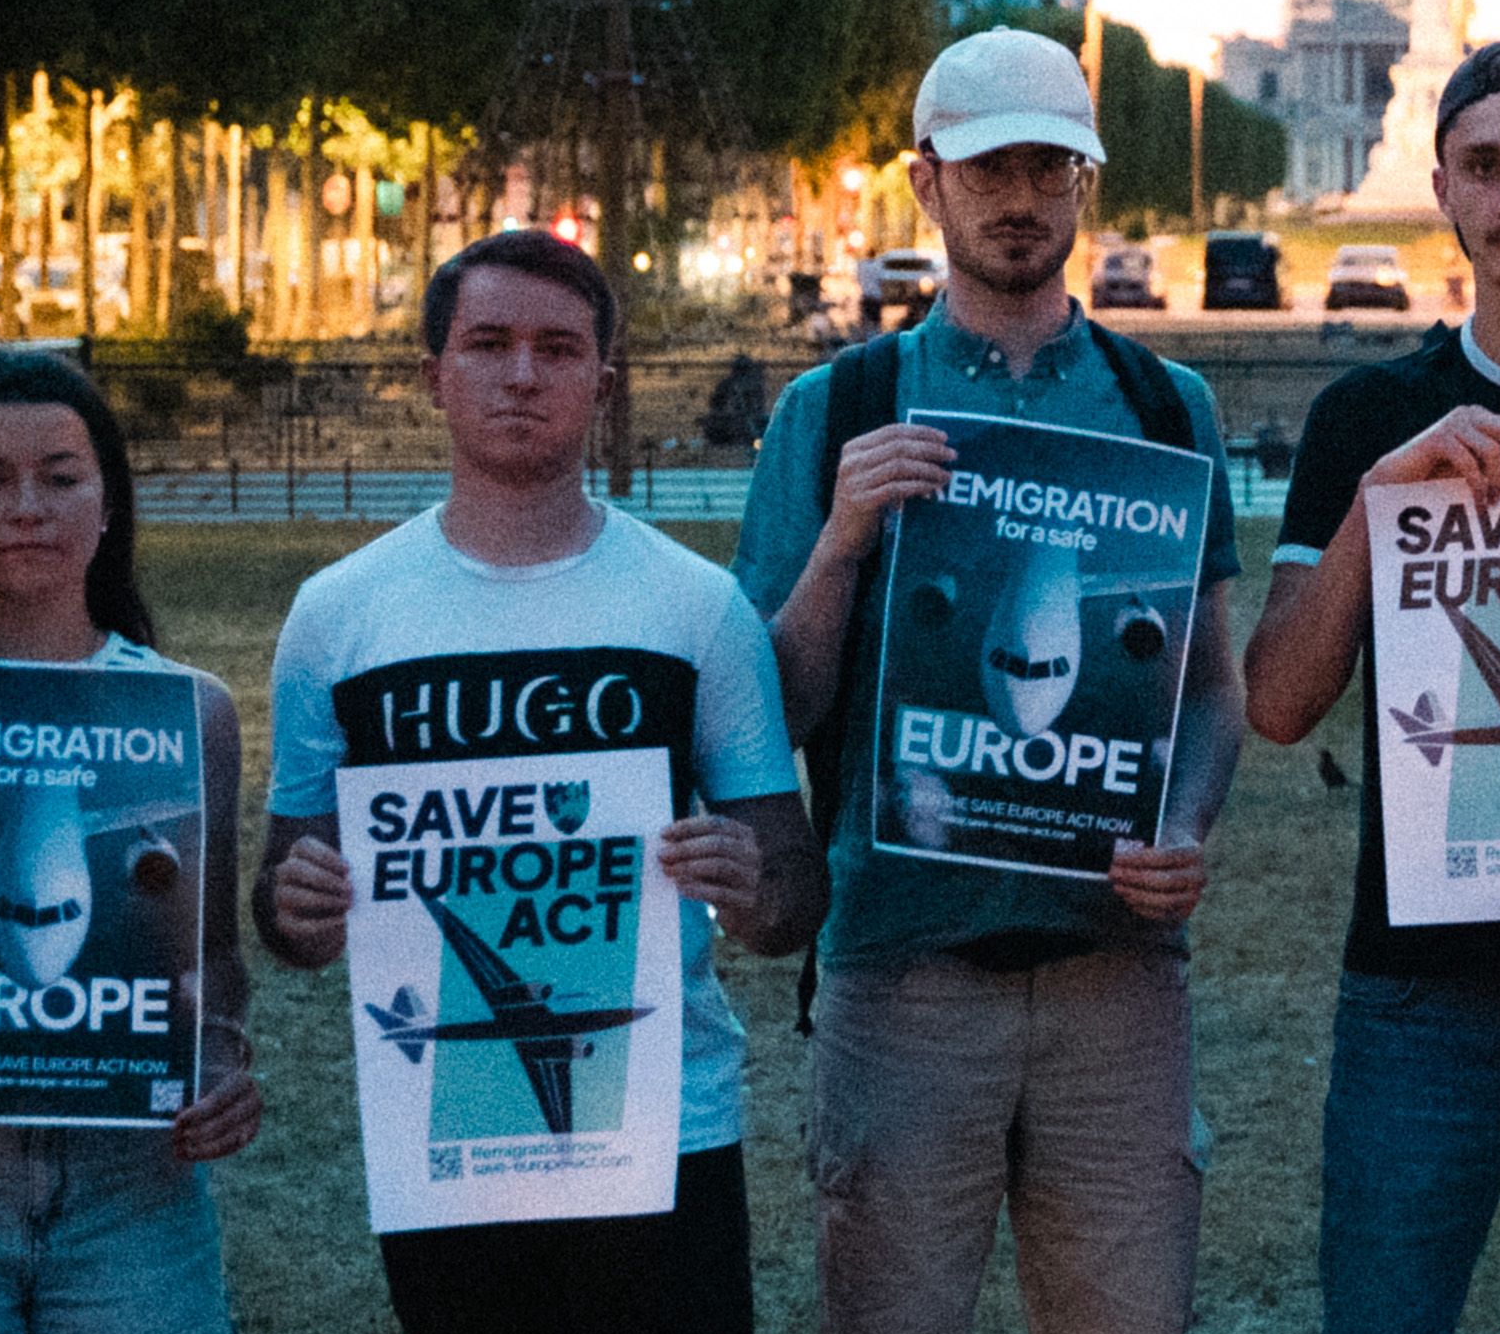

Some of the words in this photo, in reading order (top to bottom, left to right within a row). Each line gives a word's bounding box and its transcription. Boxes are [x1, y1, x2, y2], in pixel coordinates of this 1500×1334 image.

[996, 516, 1029, 540] for
[1031, 526, 1045, 543] a
[1048, 527, 1098, 551] safe
[383, 673, 642, 751] HUGO
[25, 766, 39, 784] a
[44, 764, 97, 787] safe
[900, 710, 1143, 794] EUROPE
[367, 784, 537, 844] SAVE
[970, 798, 1006, 816] SAVE
[1007, 803, 1067, 825] EUROPE
[1066, 812, 1094, 828] ACT
[1095, 817, 1133, 834] NOW
[372, 836, 636, 901] EUROPE
[498, 890, 632, 949] ACT
[32, 1057, 93, 1072] EUROPE
[96, 1059, 127, 1073] ACT
[128, 1060, 170, 1075] NOW
